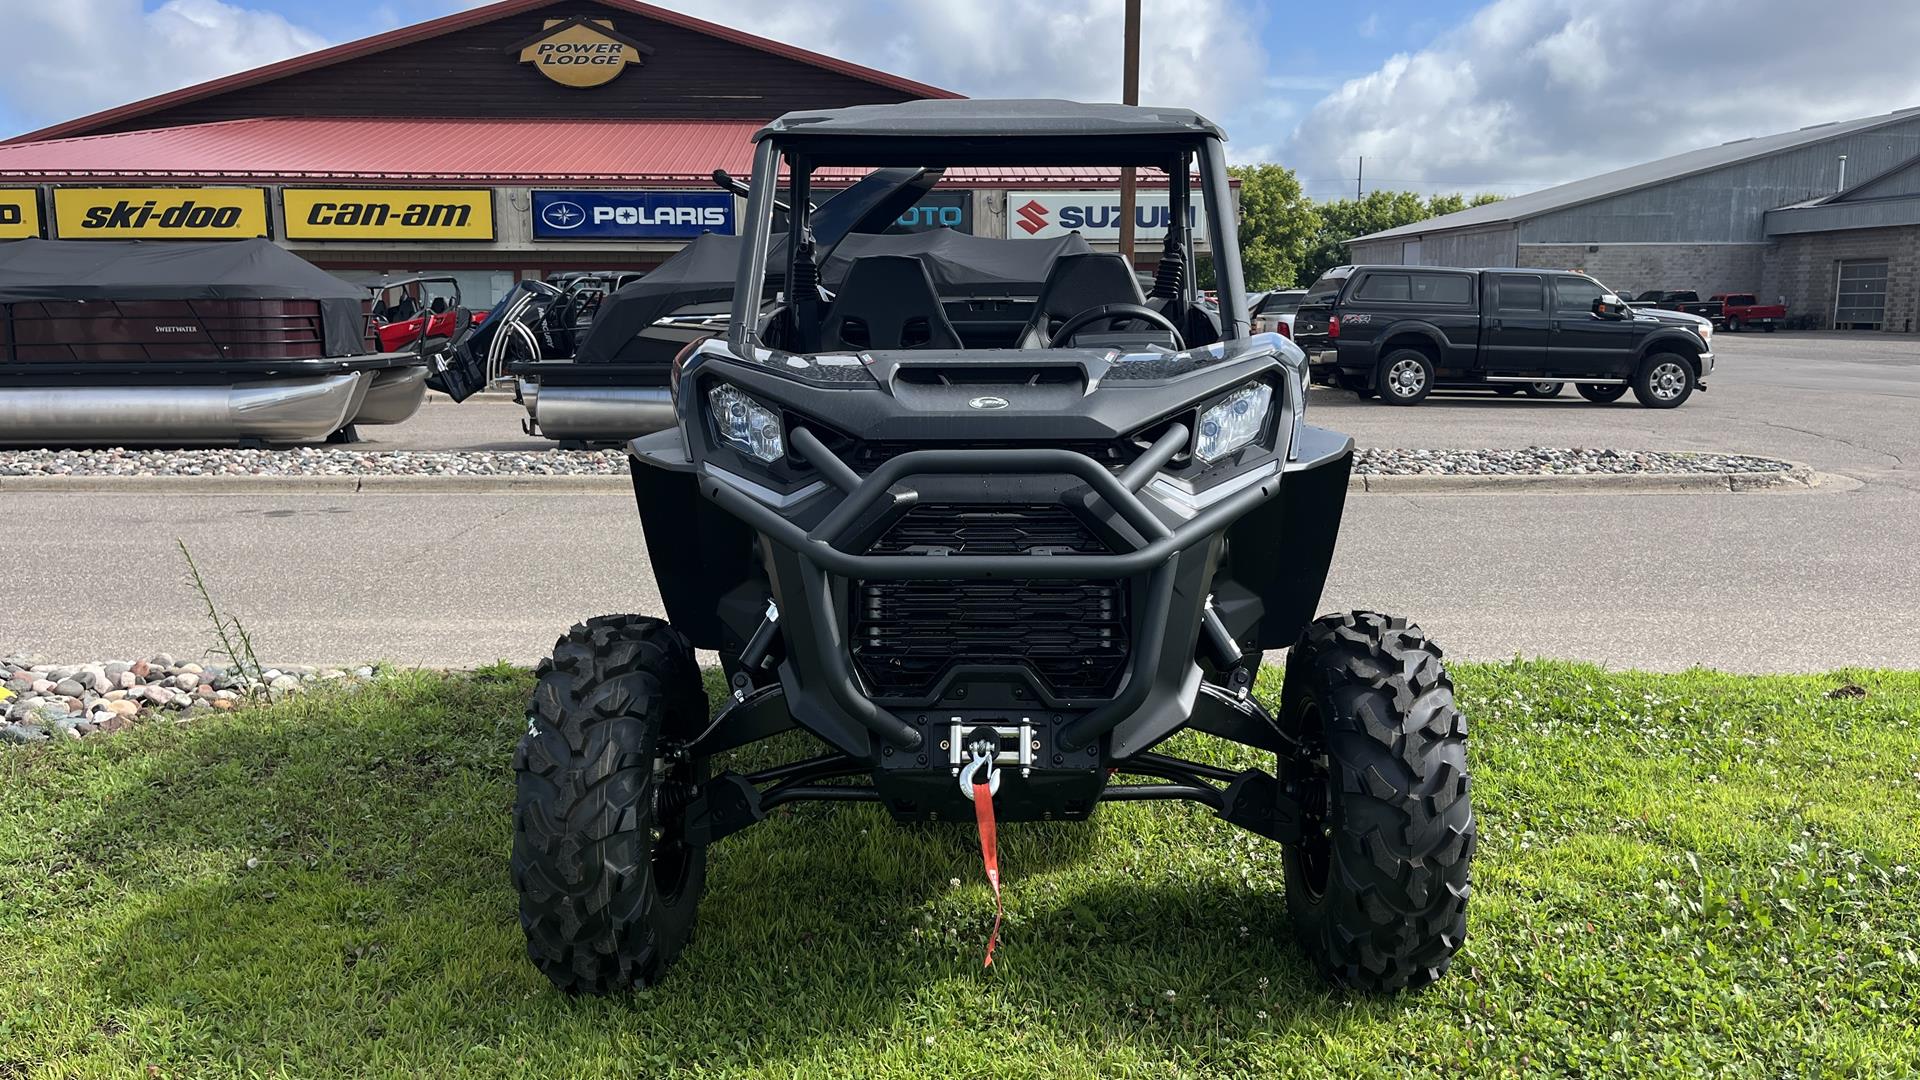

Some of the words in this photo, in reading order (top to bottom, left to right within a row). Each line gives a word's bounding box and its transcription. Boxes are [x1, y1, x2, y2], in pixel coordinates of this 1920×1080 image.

[537, 43, 623, 55] POWER
[543, 54, 620, 65] LODGE
[81, 201, 242, 229] ski-doo
[307, 203, 471, 227] can-am
[593, 207, 725, 225] POLARIS
[897, 206, 962, 226] OTO
